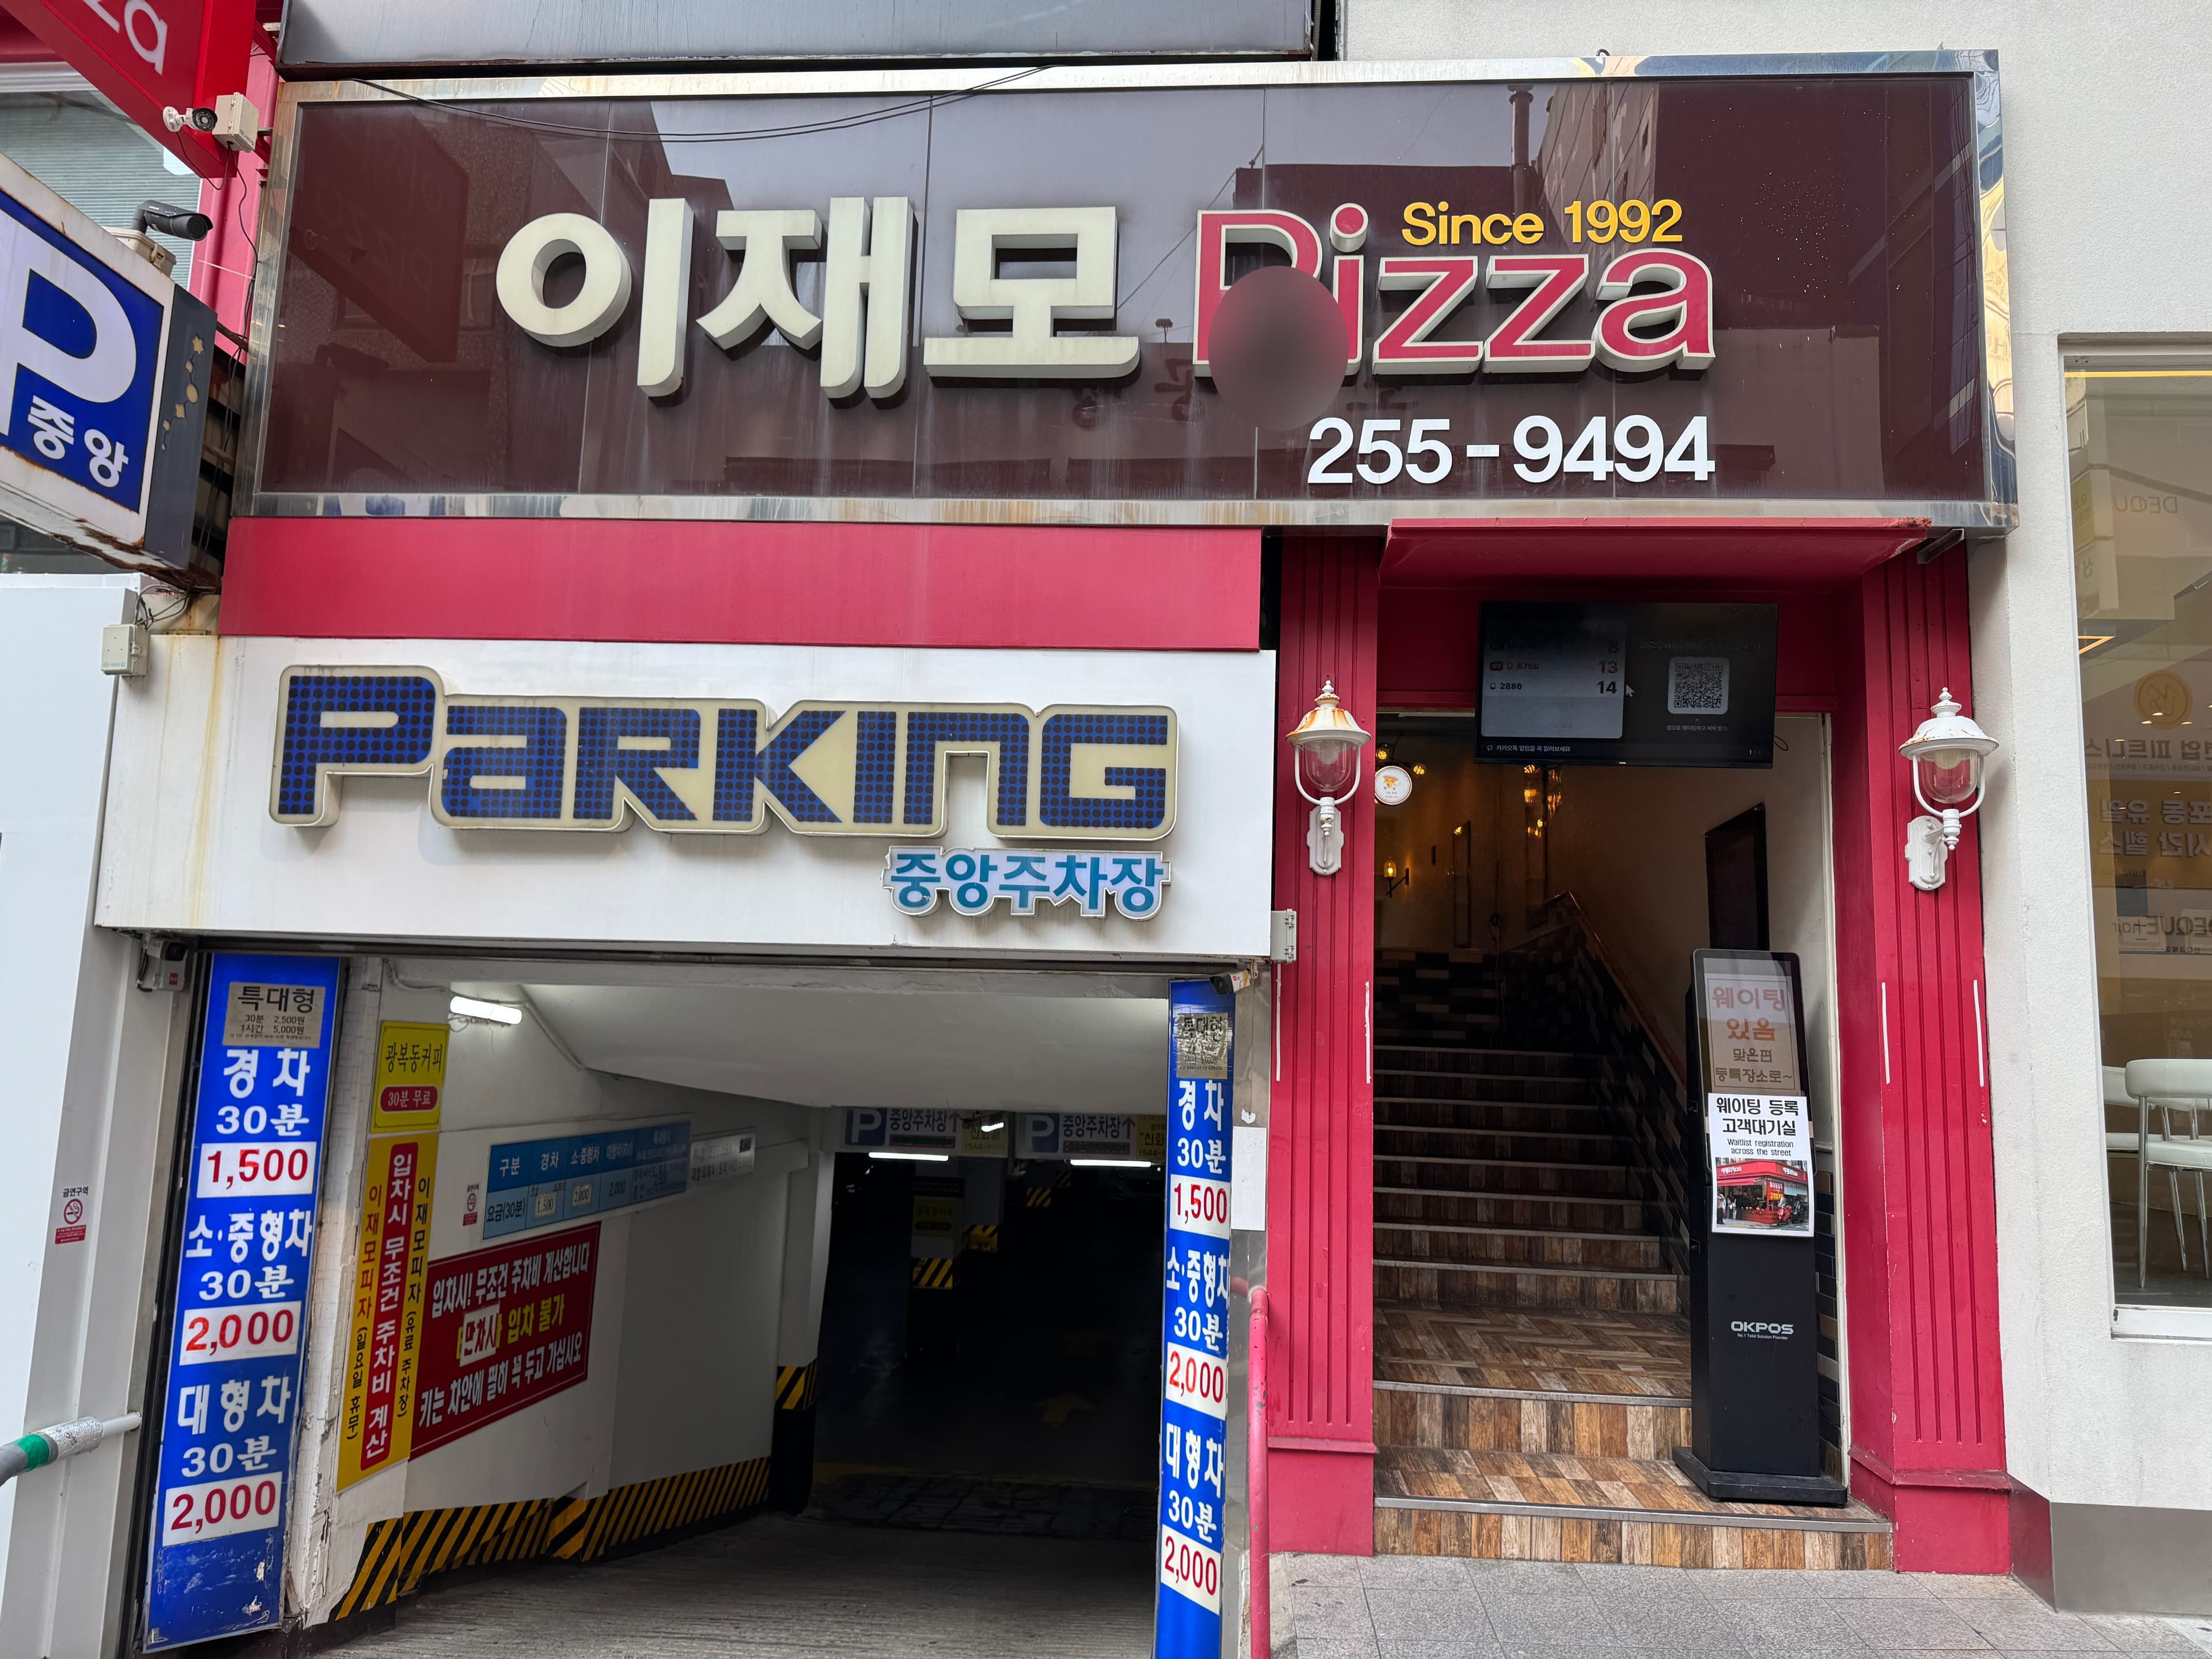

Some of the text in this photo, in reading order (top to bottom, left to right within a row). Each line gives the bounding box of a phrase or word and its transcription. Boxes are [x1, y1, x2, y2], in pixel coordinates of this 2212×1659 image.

[1402, 199, 1683, 247] Since 1992
[496, 196, 1141, 400] 이재모
[28, 395, 128, 488] 중앙
[1597, 680, 1618, 694] 14
[890, 853, 1166, 913] 중앙주차장
[237, 986, 315, 1013] 특대형
[1713, 987, 1785, 1012] 웨이팅
[241, 1024, 305, 1035] 1시간 5,000원
[245, 1014, 305, 1025] 30분 2,500원
[1726, 1017, 1775, 1041] 있음
[224, 1048, 310, 1099] 경차
[386, 1042, 442, 1073] 광복동커피
[1733, 1047, 1772, 1063] 맞은편
[388, 1090, 431, 1108] 30분 무료
[1179, 1080, 1224, 1131] 경차
[1717, 1097, 1799, 1116] 웨이팅 등록
[216, 1104, 309, 1137] 30분
[851, 1108, 882, 1143] P
[890, 1108, 948, 1132] 중앙주차장
[1063, 1115, 1121, 1138] 중앙주차장
[1722, 1118, 1796, 1136] 고객대기실
[1177, 1138, 1226, 1174] 30분
[1728, 1138, 1794, 1148] Waitlist registration
[1771, 1149, 1791, 1157] street
[207, 1149, 308, 1190] 1,500
[499, 1157, 520, 1177] 구분
[540, 1150, 559, 1171] 경차
[63, 1186, 89, 1198] 금연구역
[486, 1200, 525, 1222] 요금(30분)
[609, 1180, 626, 1197] 2,000
[1174, 1183, 1228, 1224] 1,500
[199, 1265, 294, 1301] 30분
[432, 1241, 590, 1319] 입차시! 무조건 주차비 계산합니다
[366, 1154, 412, 1459] 입차시 무조건 주차비 계산
[507, 1302, 535, 1344] 입차
[539, 1293, 565, 1333] 불가
[185, 1309, 294, 1355] 2,000
[1174, 1307, 1223, 1351] 30분
[1731, 1320, 1794, 1335] OKPOS
[419, 1386, 445, 1428] 키는
[448, 1369, 484, 1415] 차안에
[487, 1359, 509, 1402] 필히
[525, 1346, 545, 1384] 두고
[547, 1331, 582, 1374] 가십시오
[1169, 1351, 1224, 1403] 2,000
[177, 1376, 291, 1434] 대형차
[181, 1436, 276, 1478] 30분
[1166, 1422, 1225, 1499] 대형차
[171, 1480, 276, 1533] 2,000
[1168, 1490, 1217, 1543] 30분
[1165, 1535, 1217, 1596] 2,000
